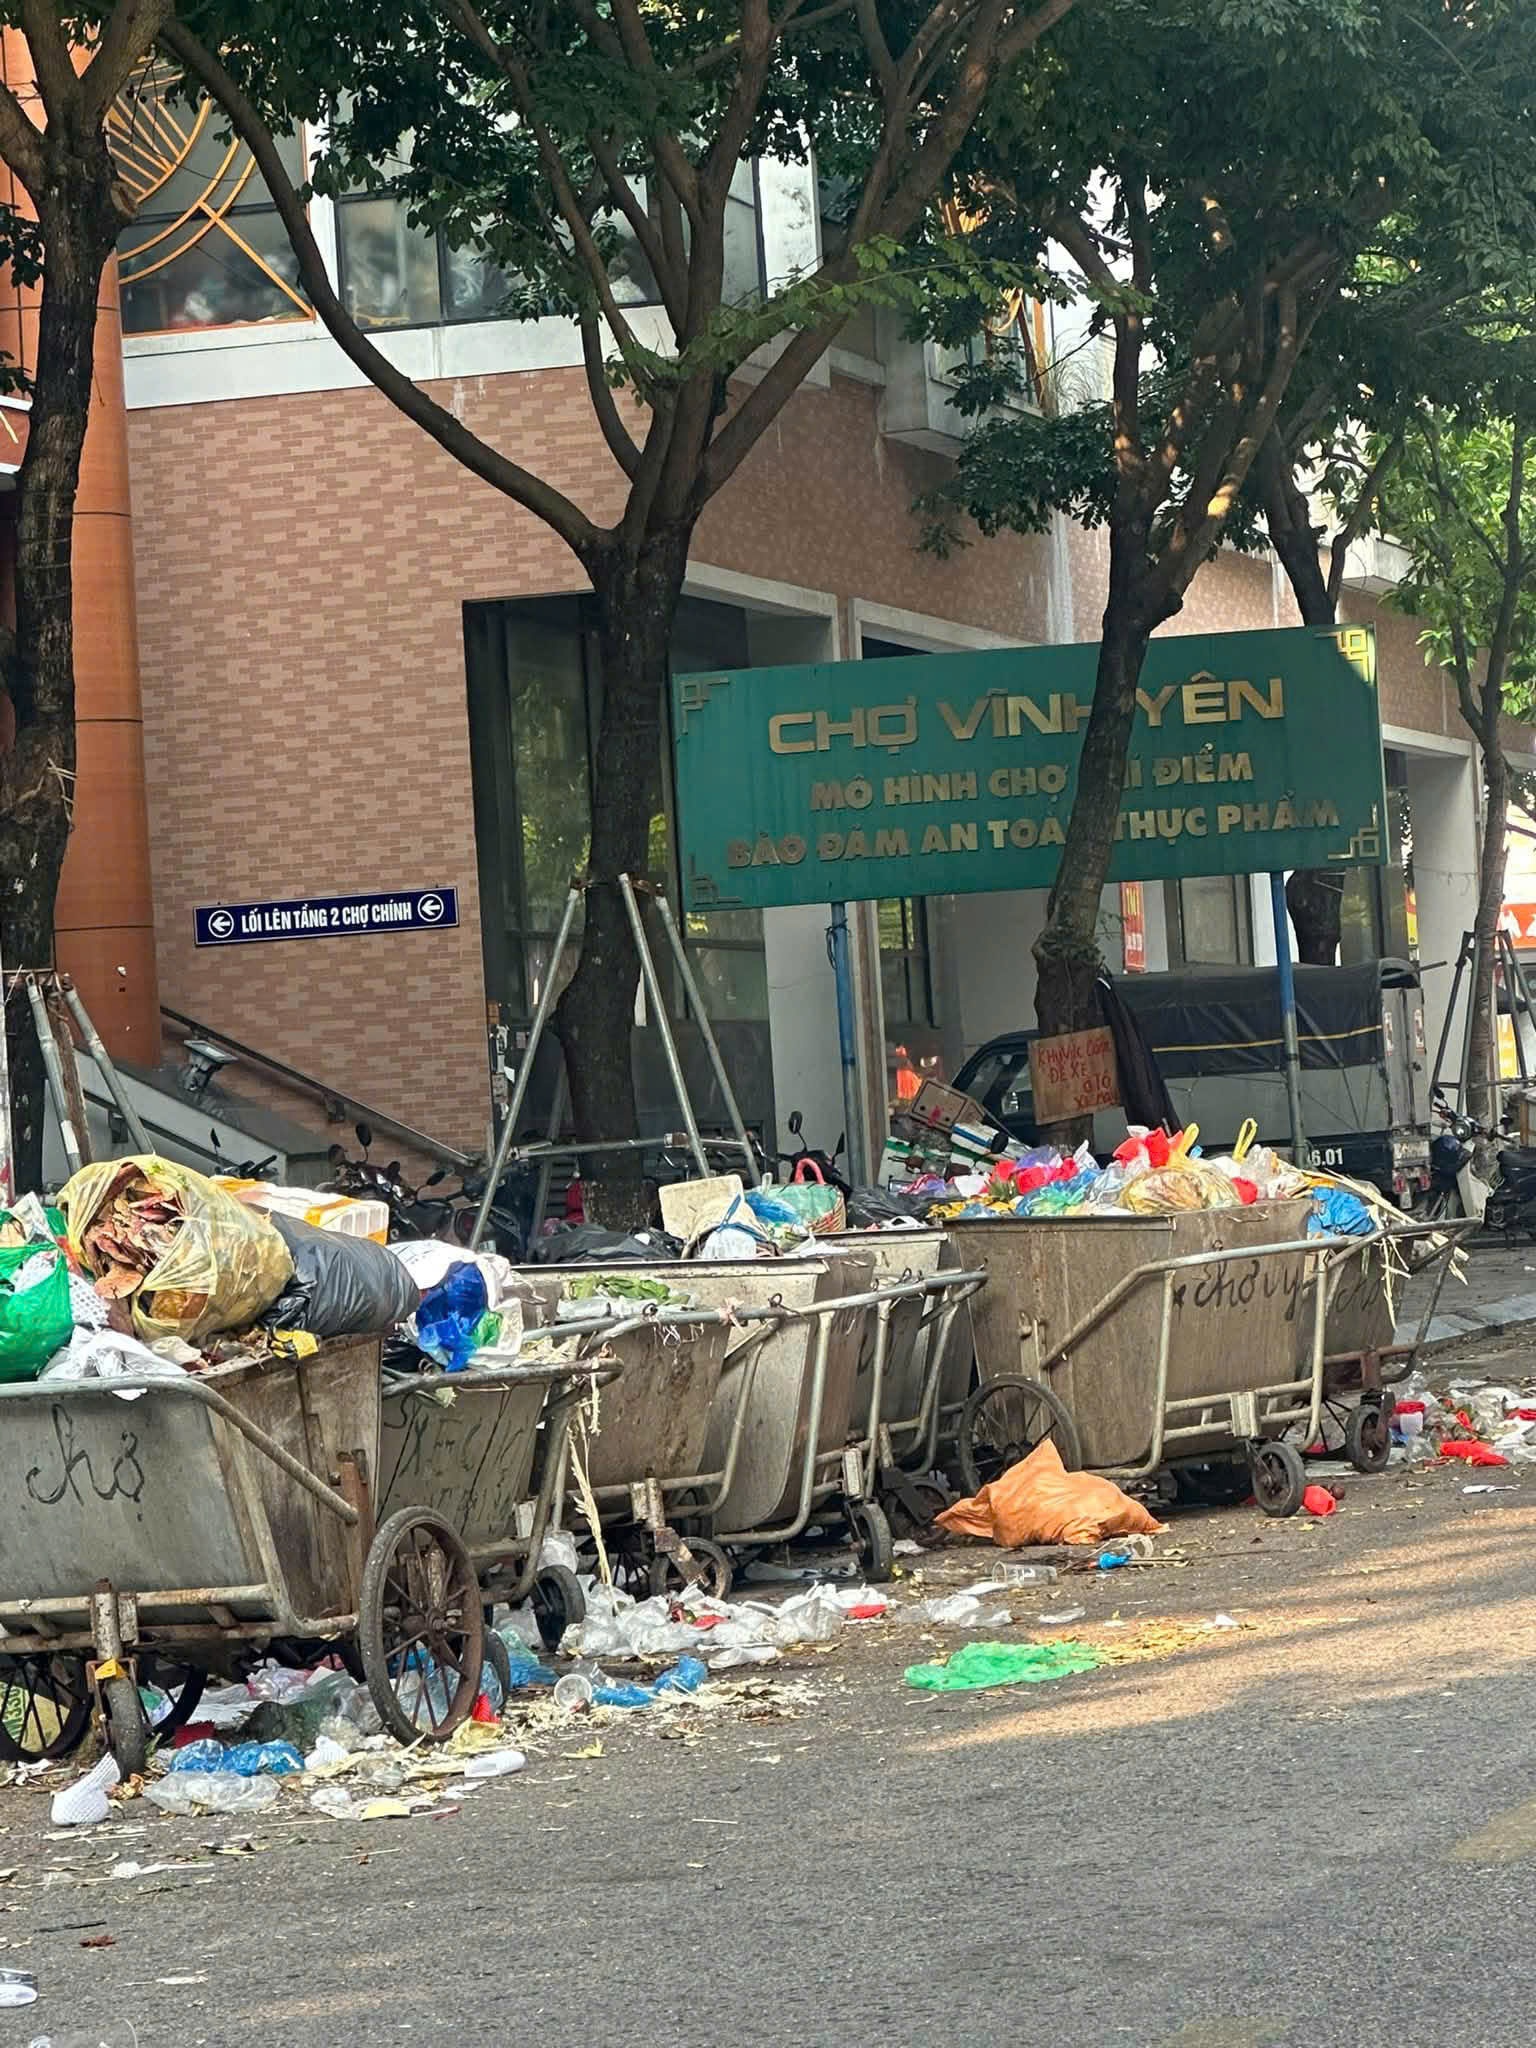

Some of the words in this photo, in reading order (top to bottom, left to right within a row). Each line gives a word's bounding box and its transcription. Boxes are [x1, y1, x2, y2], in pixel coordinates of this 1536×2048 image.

[769, 695, 918, 756] CHỢ
[1135, 670, 1286, 728] YÊN
[811, 773, 873, 812] MÔ
[883, 768, 978, 806] HÌNH
[988, 763, 1070, 803] CHỢ
[1153, 742, 1254, 787] ĐIỂM
[727, 831, 808, 869] BẢO
[817, 823, 911, 862] ĐẢM
[920, 822, 979, 853] AN
[987, 809, 1073, 849] TOÀ
[1217, 789, 1340, 835] PHẨM
[241, 907, 263, 933] LỐI
[264, 908, 291, 931] LÊN
[292, 903, 329, 929] TẦNG
[330, 907, 341, 926] 2
[342, 903, 370, 929] CHỢ
[371, 899, 413, 924] CHÍNH
[1307, 1147, 1343, 1167] 6.01
